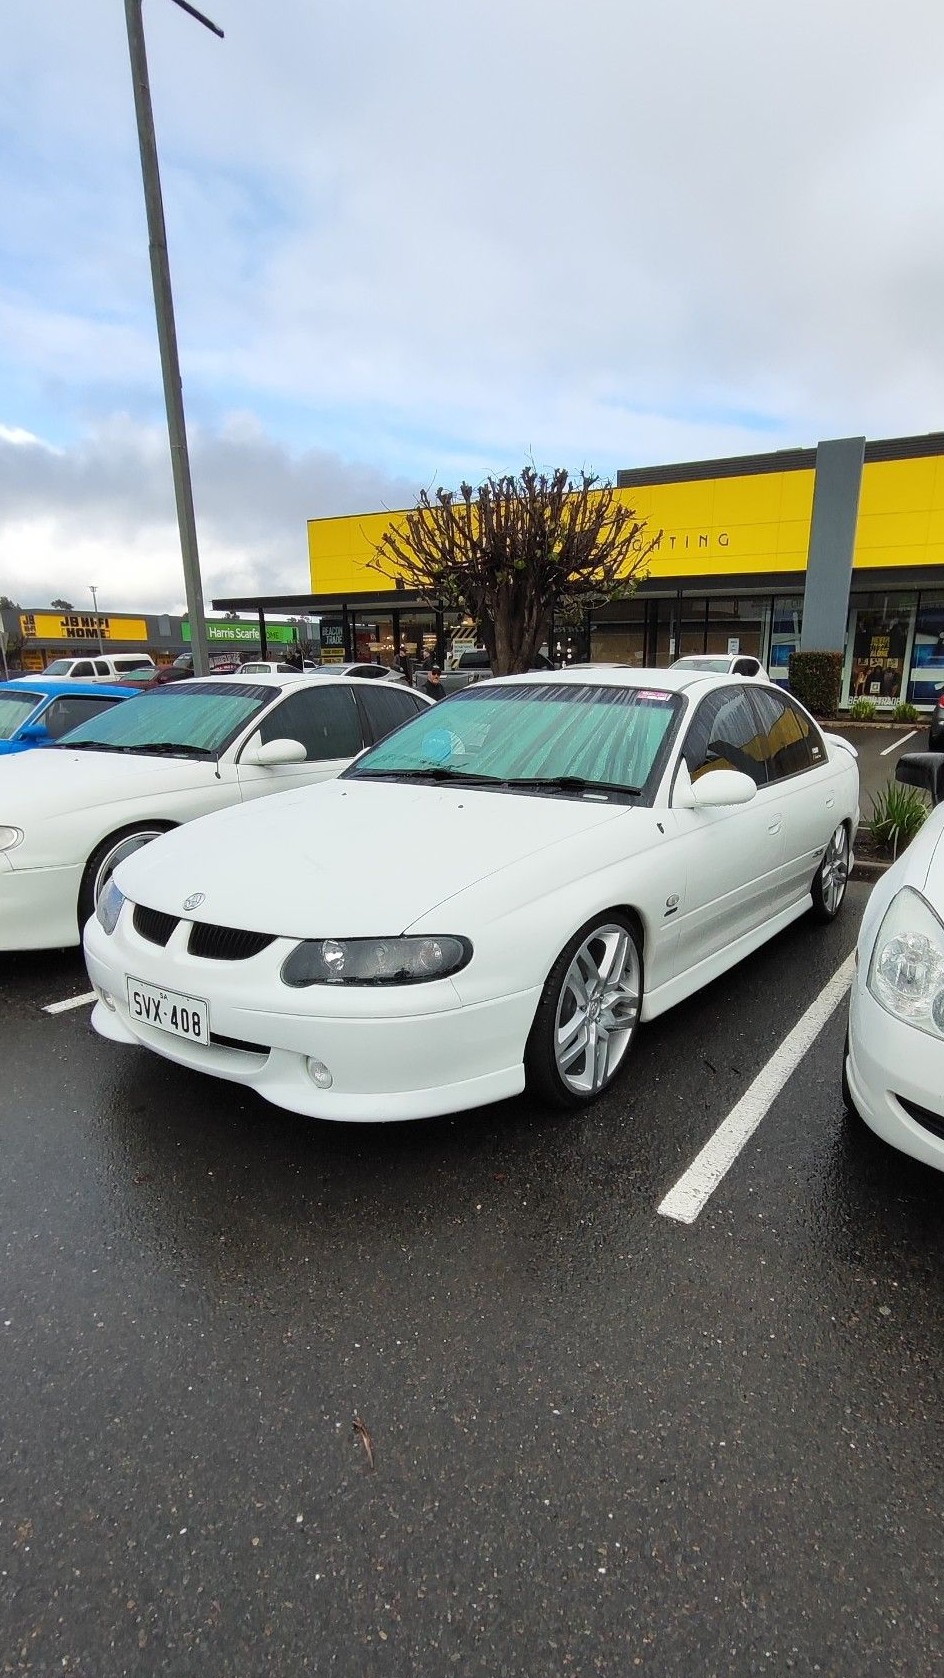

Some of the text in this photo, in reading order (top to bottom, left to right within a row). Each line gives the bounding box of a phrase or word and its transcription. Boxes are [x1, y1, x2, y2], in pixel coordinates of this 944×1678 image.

[60, 616, 79, 627] JB
[66, 628, 106, 638] HOME
[209, 626, 235, 639] Harris
[236, 628, 260, 639] Scarfe
[322, 626, 343, 636] BEACON
[326, 636, 343, 645] TRADE
[159, 992, 168, 1000] SA
